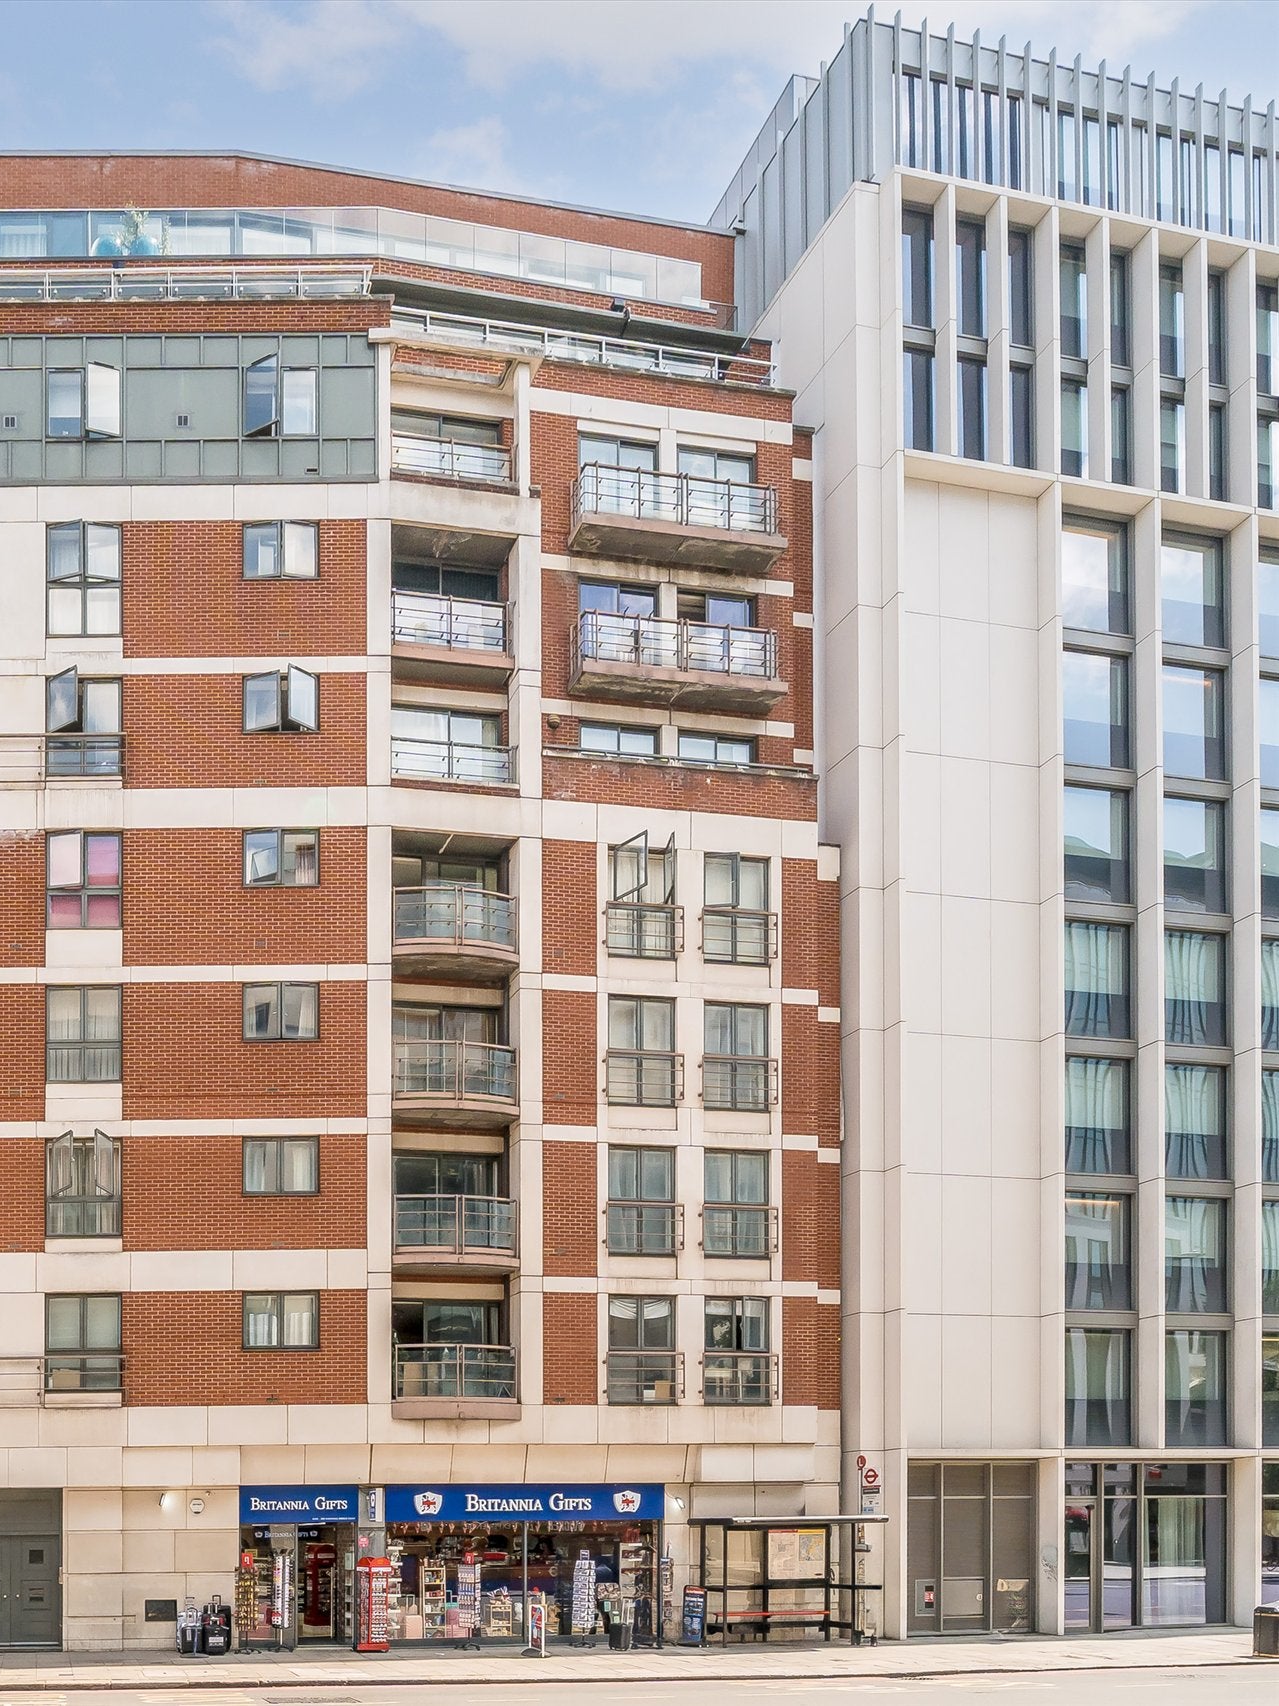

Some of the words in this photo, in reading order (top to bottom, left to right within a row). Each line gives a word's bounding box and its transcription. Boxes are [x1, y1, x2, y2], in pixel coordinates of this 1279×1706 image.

[250, 1497, 310, 1511] BRITANNIA
[314, 1496, 348, 1510] GIFTS
[465, 1494, 544, 1512] BRITANNIA
[548, 1493, 592, 1511] GIFTS
